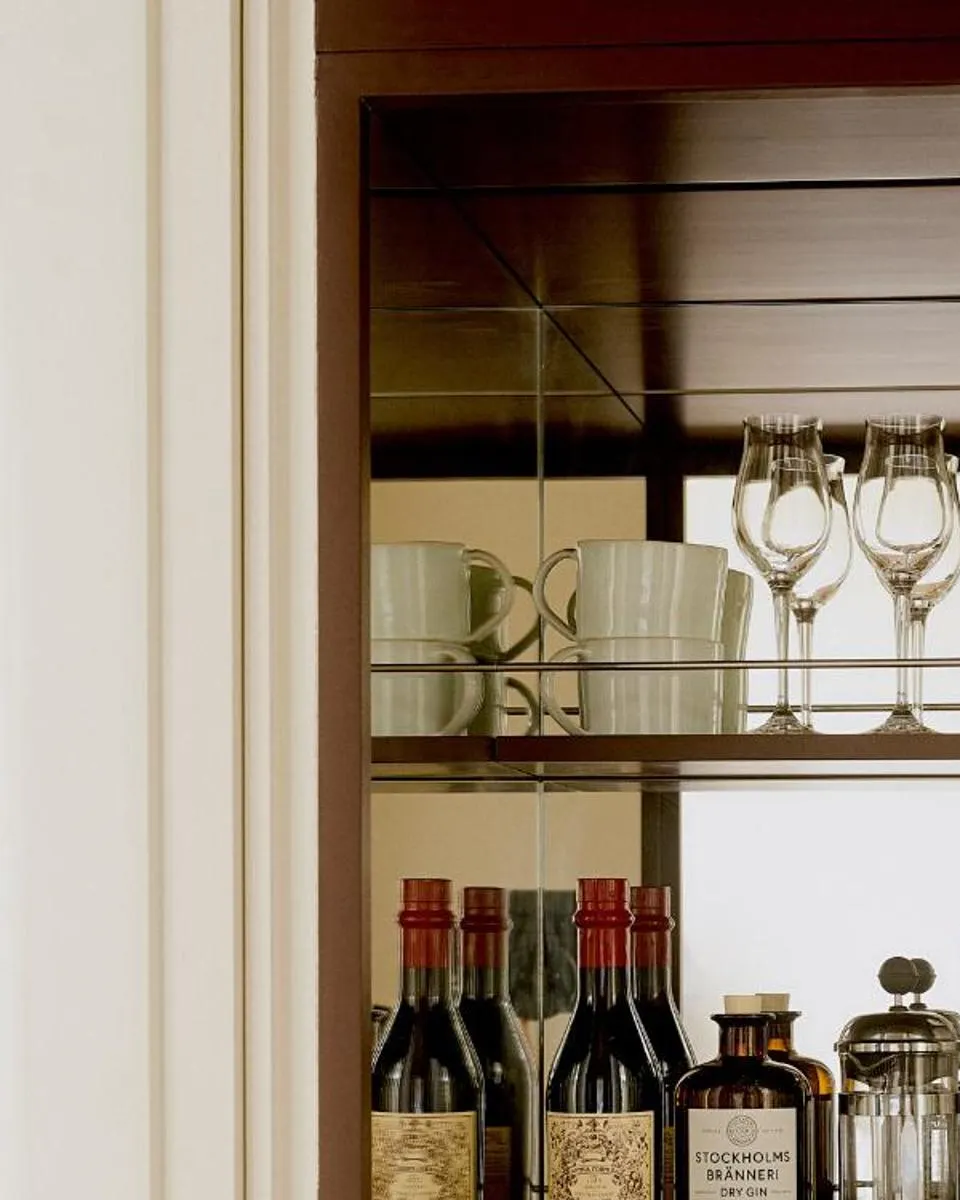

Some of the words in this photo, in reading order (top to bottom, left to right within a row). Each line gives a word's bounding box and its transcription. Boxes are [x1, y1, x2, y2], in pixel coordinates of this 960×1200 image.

[695, 1151, 791, 1164] STOCKHOLMS
[706, 1166, 779, 1181] BRÄNNERI
[720, 1187, 742, 1198] DRY
[745, 1187, 768, 1198] GIN
